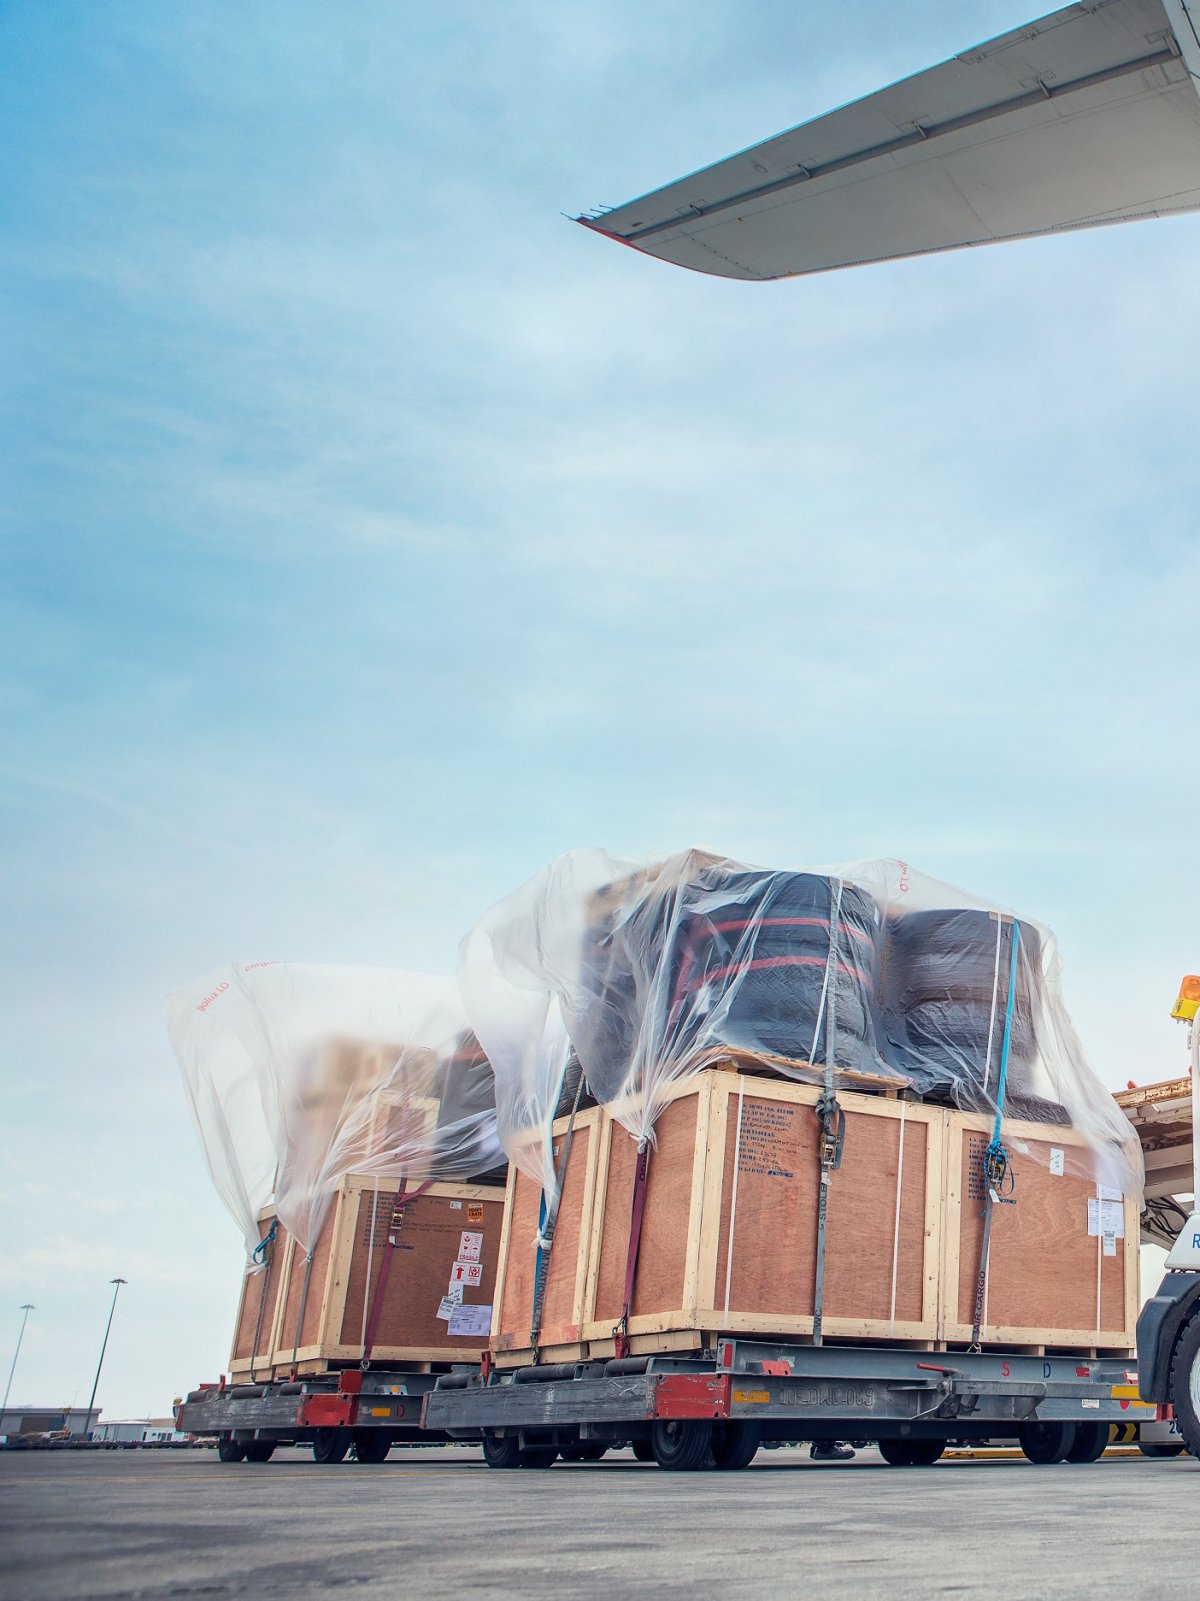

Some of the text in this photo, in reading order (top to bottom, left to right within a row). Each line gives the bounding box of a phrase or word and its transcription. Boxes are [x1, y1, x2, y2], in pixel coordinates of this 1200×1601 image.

[976, 1270, 986, 1310] CARGO
[1001, 1361, 1051, 1378] S D
